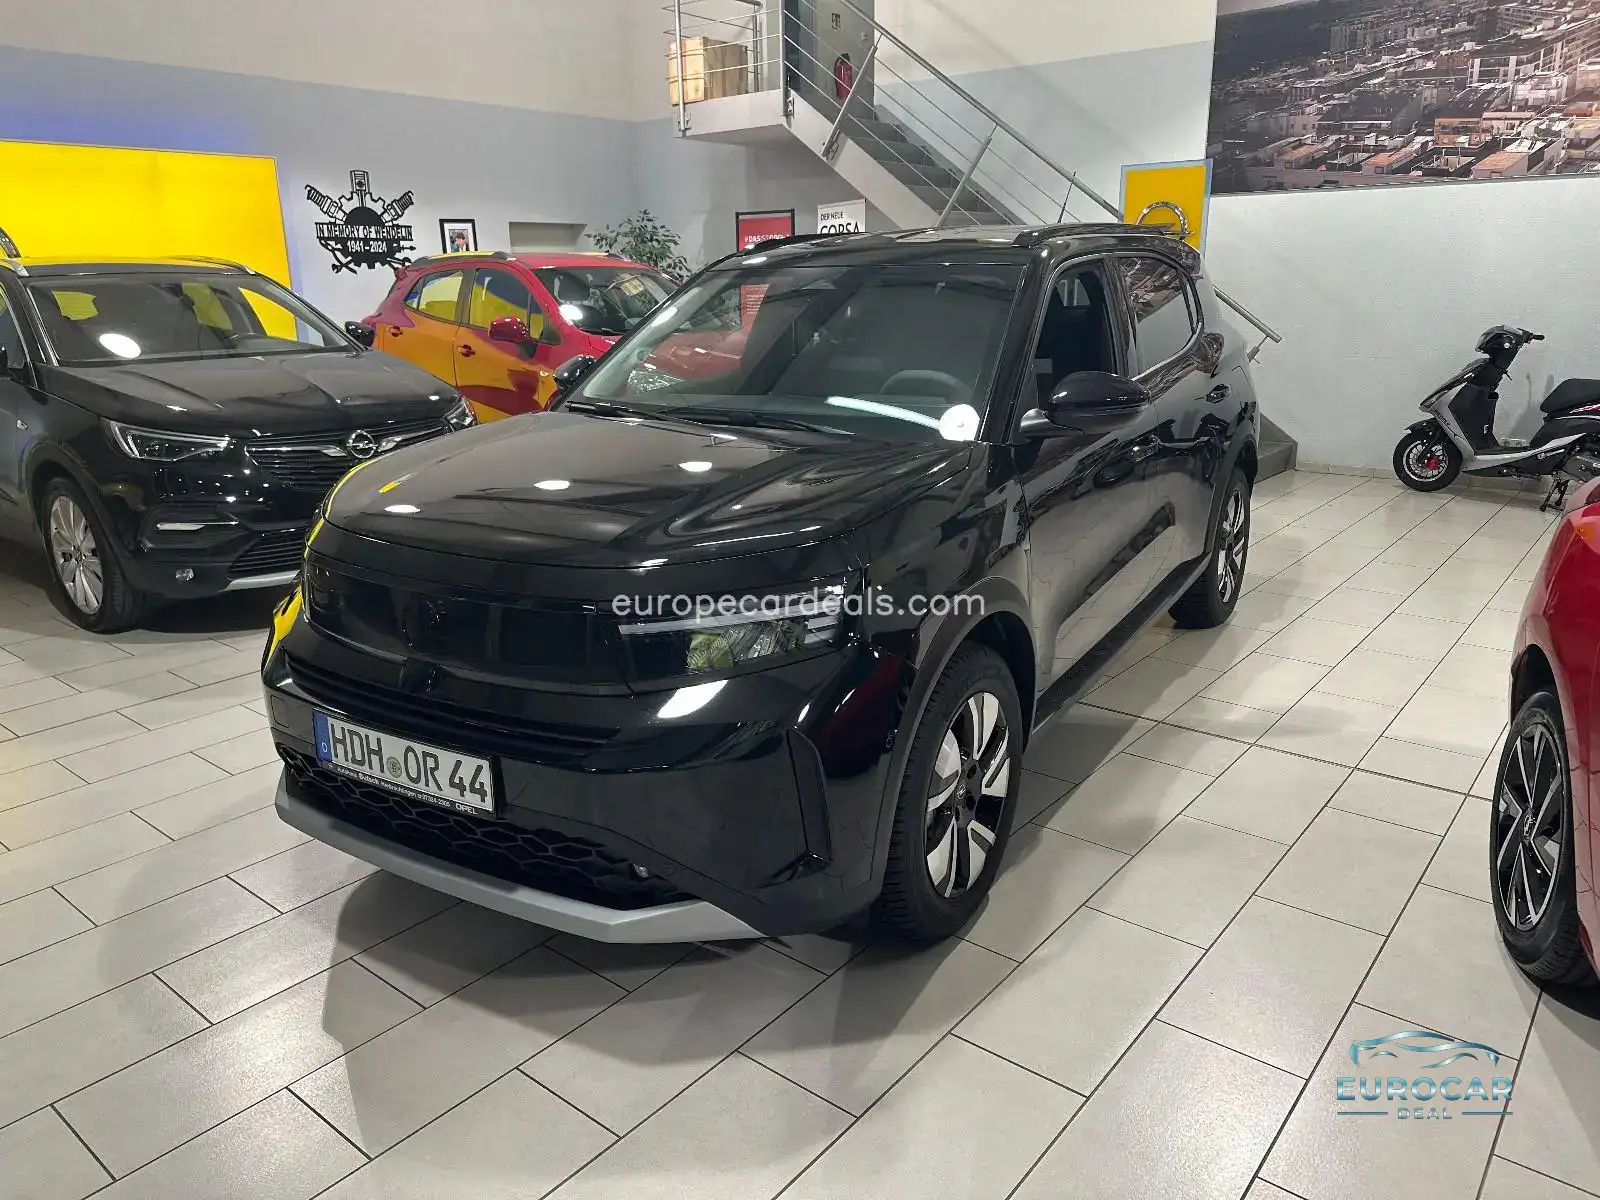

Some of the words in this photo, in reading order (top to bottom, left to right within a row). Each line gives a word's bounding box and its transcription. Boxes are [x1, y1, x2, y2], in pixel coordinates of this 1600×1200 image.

[820, 213, 831, 221] DER
[316, 224, 325, 238] IN
[327, 224, 360, 238] MEMORY
[362, 225, 373, 239] OF
[375, 225, 413, 240] WENDELIN
[820, 221, 860, 234] CORSA
[330, 723, 385, 774] HDH
[403, 745, 443, 792] OR
[449, 759, 488, 803] 44
[455, 803, 479, 815] OPEL
